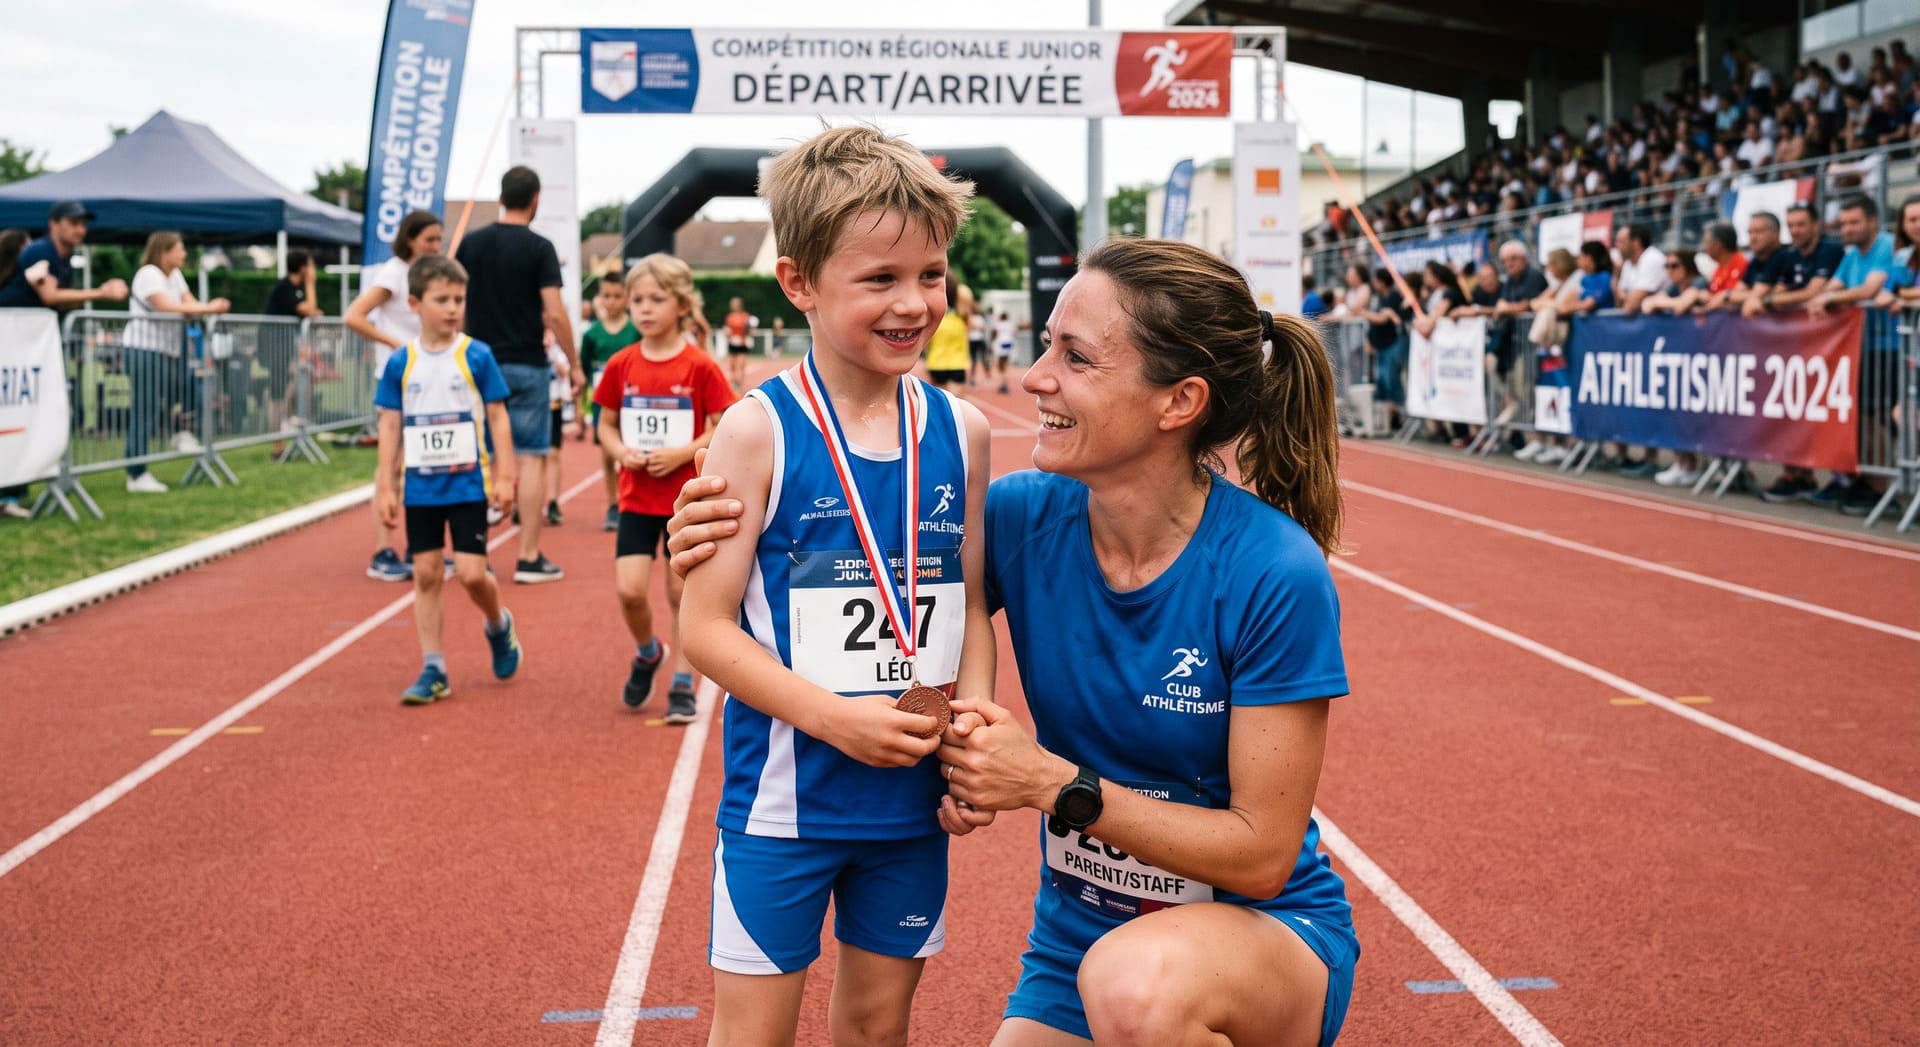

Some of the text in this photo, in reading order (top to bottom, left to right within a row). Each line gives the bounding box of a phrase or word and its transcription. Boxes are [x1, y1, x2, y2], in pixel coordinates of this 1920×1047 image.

[712, 34, 1103, 59] COMPÉTITION RÉGIONALE JUNIOR
[733, 63, 1082, 110] DÉPART/ARRIVÉE
[1167, 88, 1220, 109] 2024
[377, 40, 424, 243] COMPÉTITION
[403, 55, 452, 215] ÉGIONALE
[1578, 336, 1853, 423] ATHLÉTISME 2024
[636, 415, 669, 435] 191
[421, 430, 454, 450] 167
[876, 656, 912, 682] LÉO
[1166, 682, 1202, 698] CLUB
[1142, 694, 1225, 714] ATHLÉTISME
[1064, 850, 1186, 896] PARENT/STAFF
